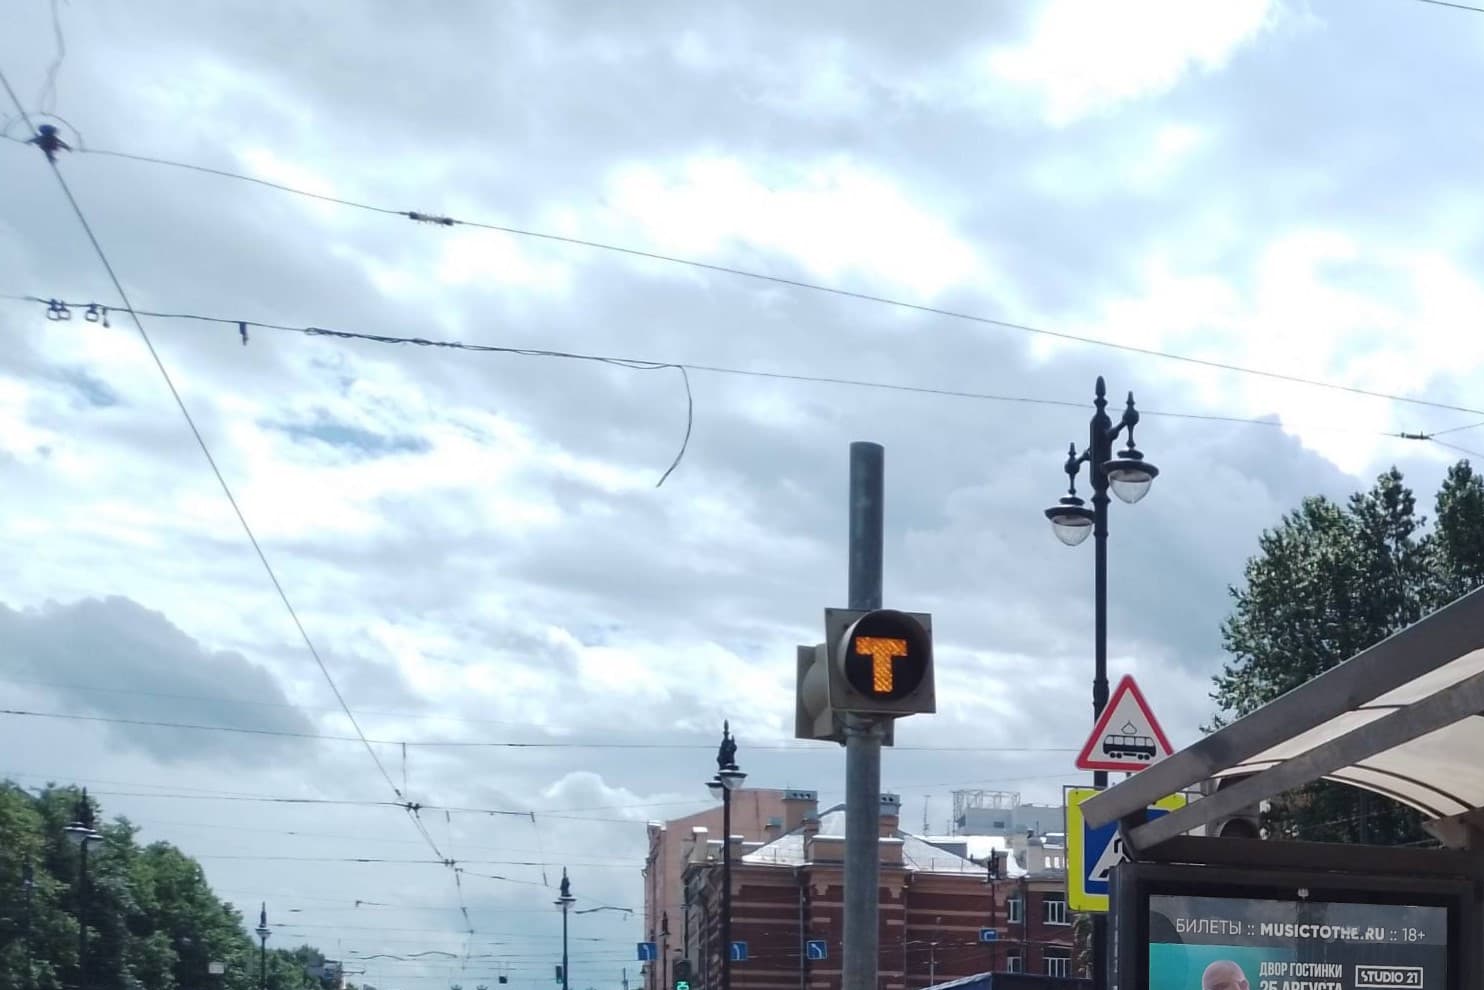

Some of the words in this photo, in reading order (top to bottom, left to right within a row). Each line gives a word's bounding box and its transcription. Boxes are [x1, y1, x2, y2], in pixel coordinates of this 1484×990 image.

[1176, 918, 1241, 936] БИЛЕТЫ
[1260, 922, 1385, 941] MUSICTOTHE.RU
[1402, 927, 1426, 942] 18+
[1259, 962, 1288, 979] ДВОР
[1289, 963, 1343, 978] ГОСТИНКИ
[1361, 971, 1403, 984] STUDIO
[1406, 972, 1418, 984] 21
